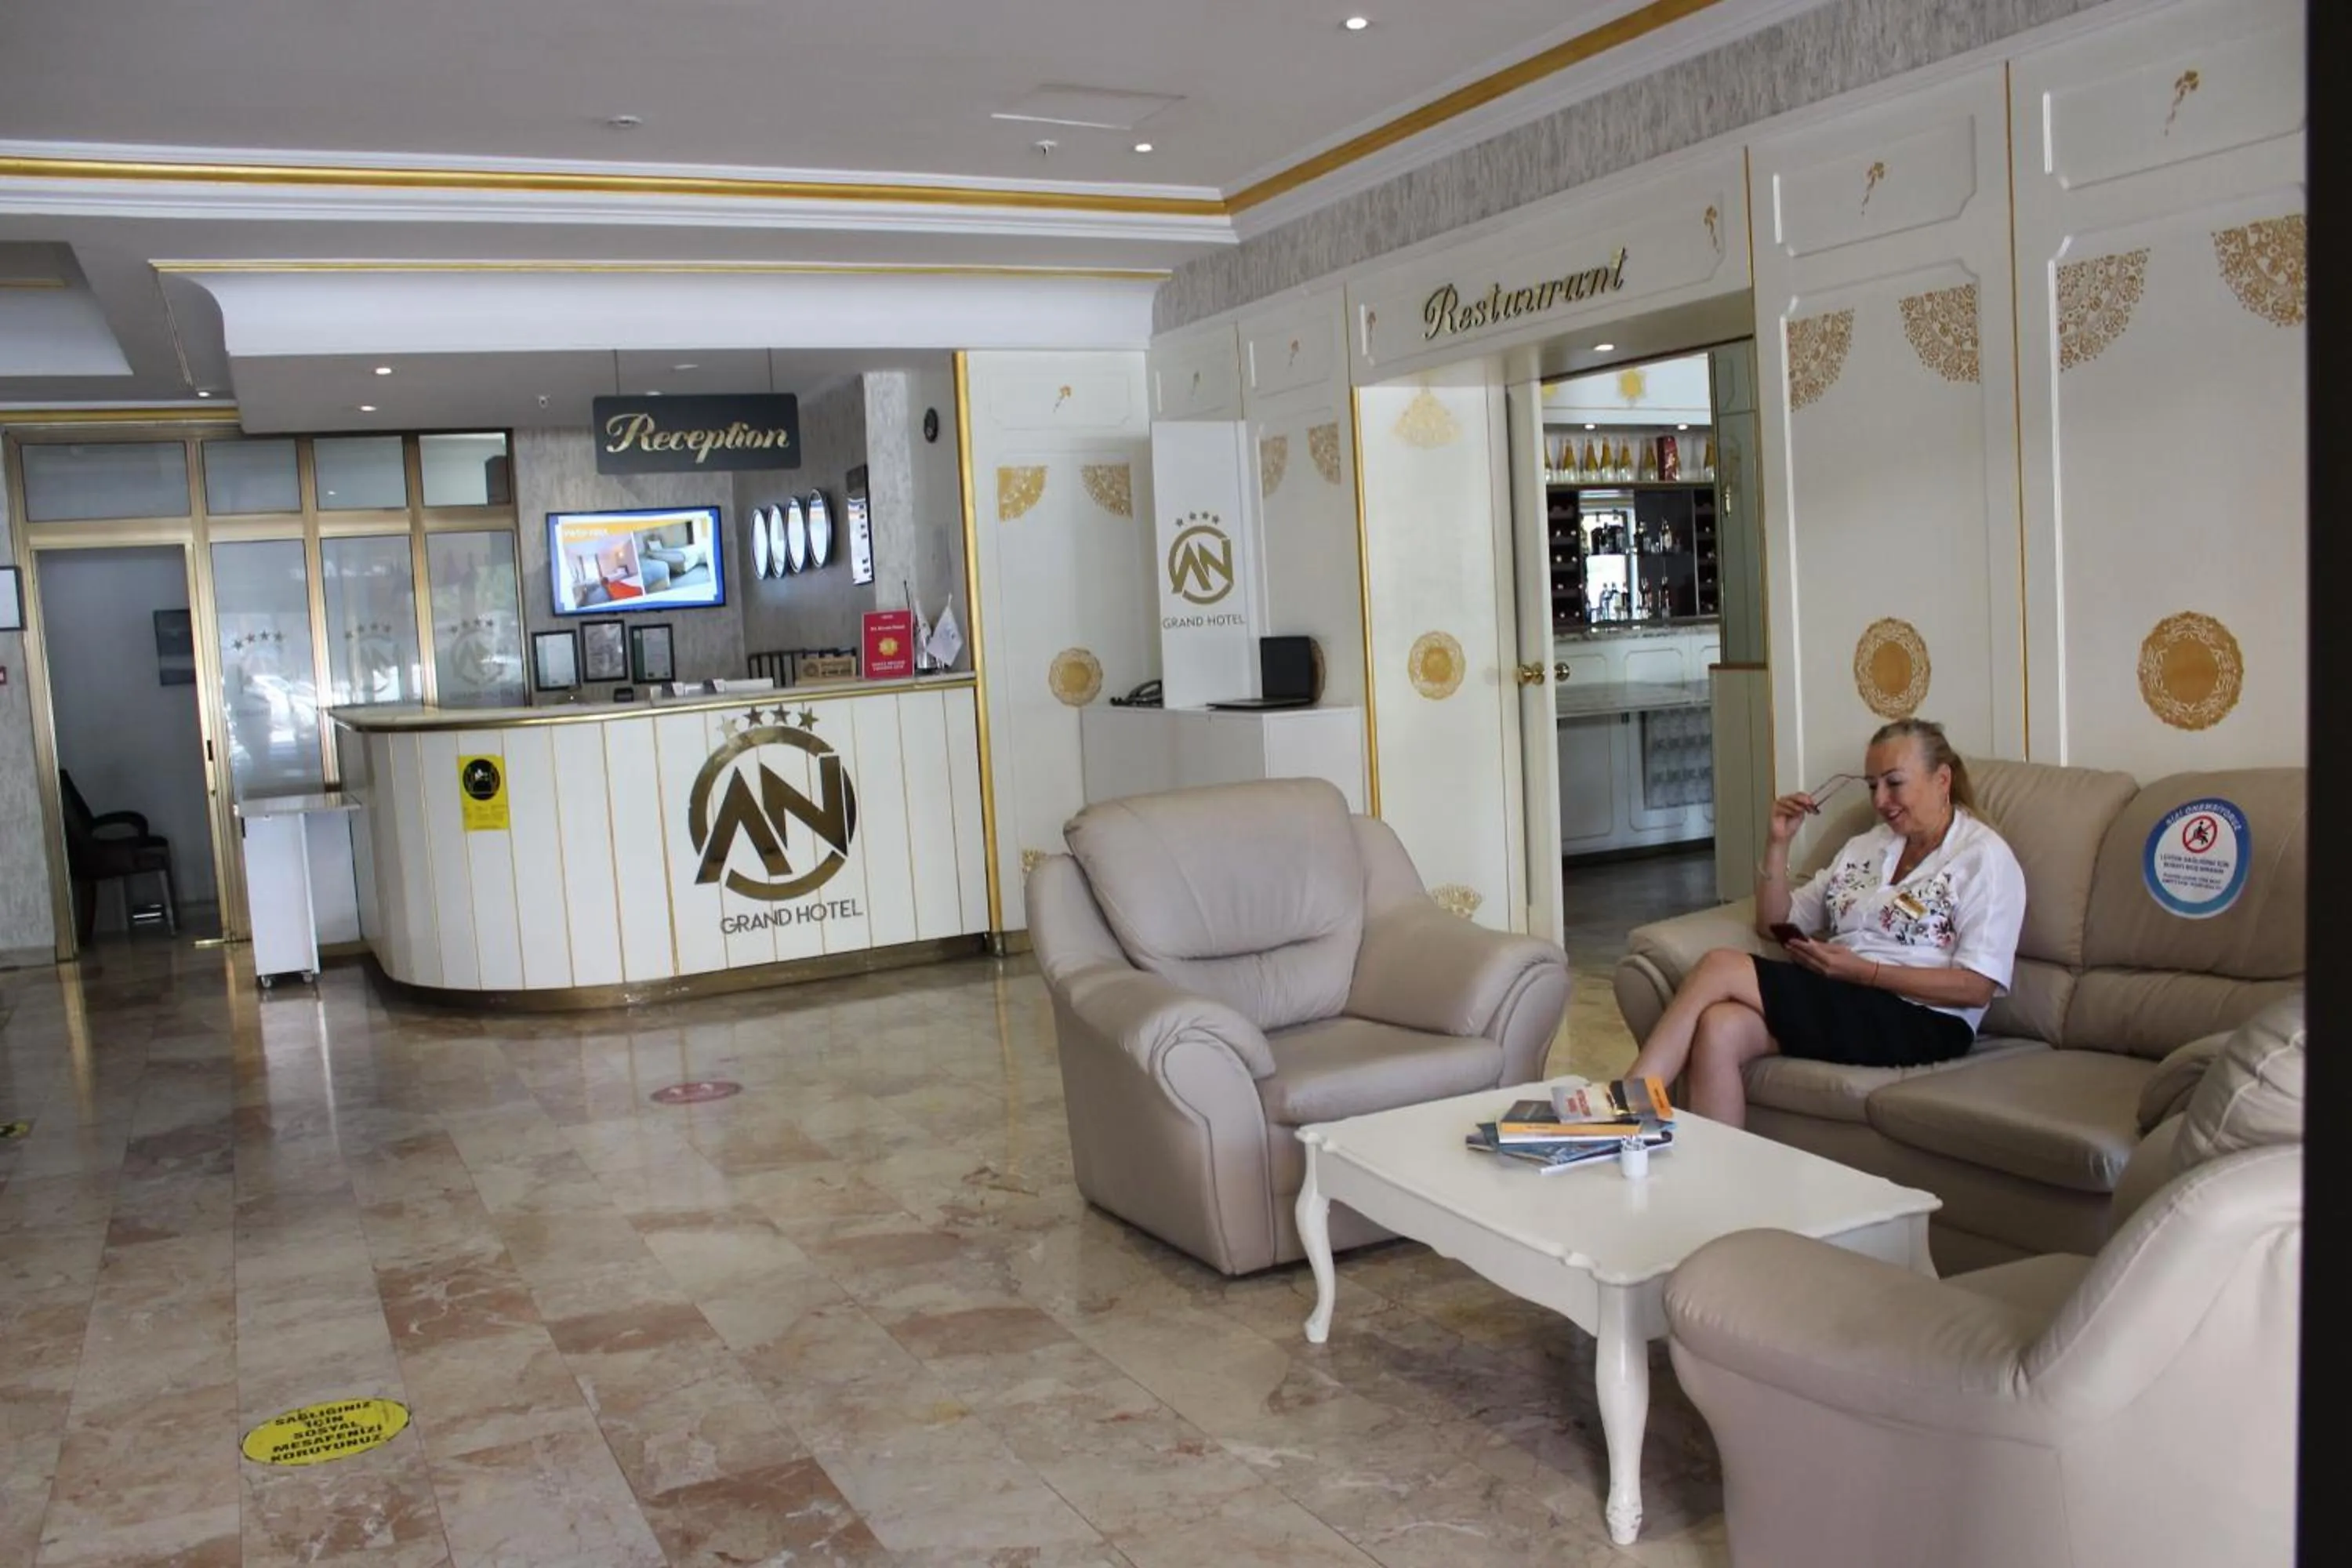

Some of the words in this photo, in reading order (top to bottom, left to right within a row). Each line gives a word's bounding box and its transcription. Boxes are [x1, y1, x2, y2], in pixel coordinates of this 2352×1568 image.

[1422, 246, 1628, 340] Restaurant
[605, 413, 790, 463] Reception
[1162, 616, 1203, 630] GRAND
[1207, 614, 1246, 626] HOTEL
[720, 908, 793, 935] GRAND
[797, 898, 863, 924] HOTEL
